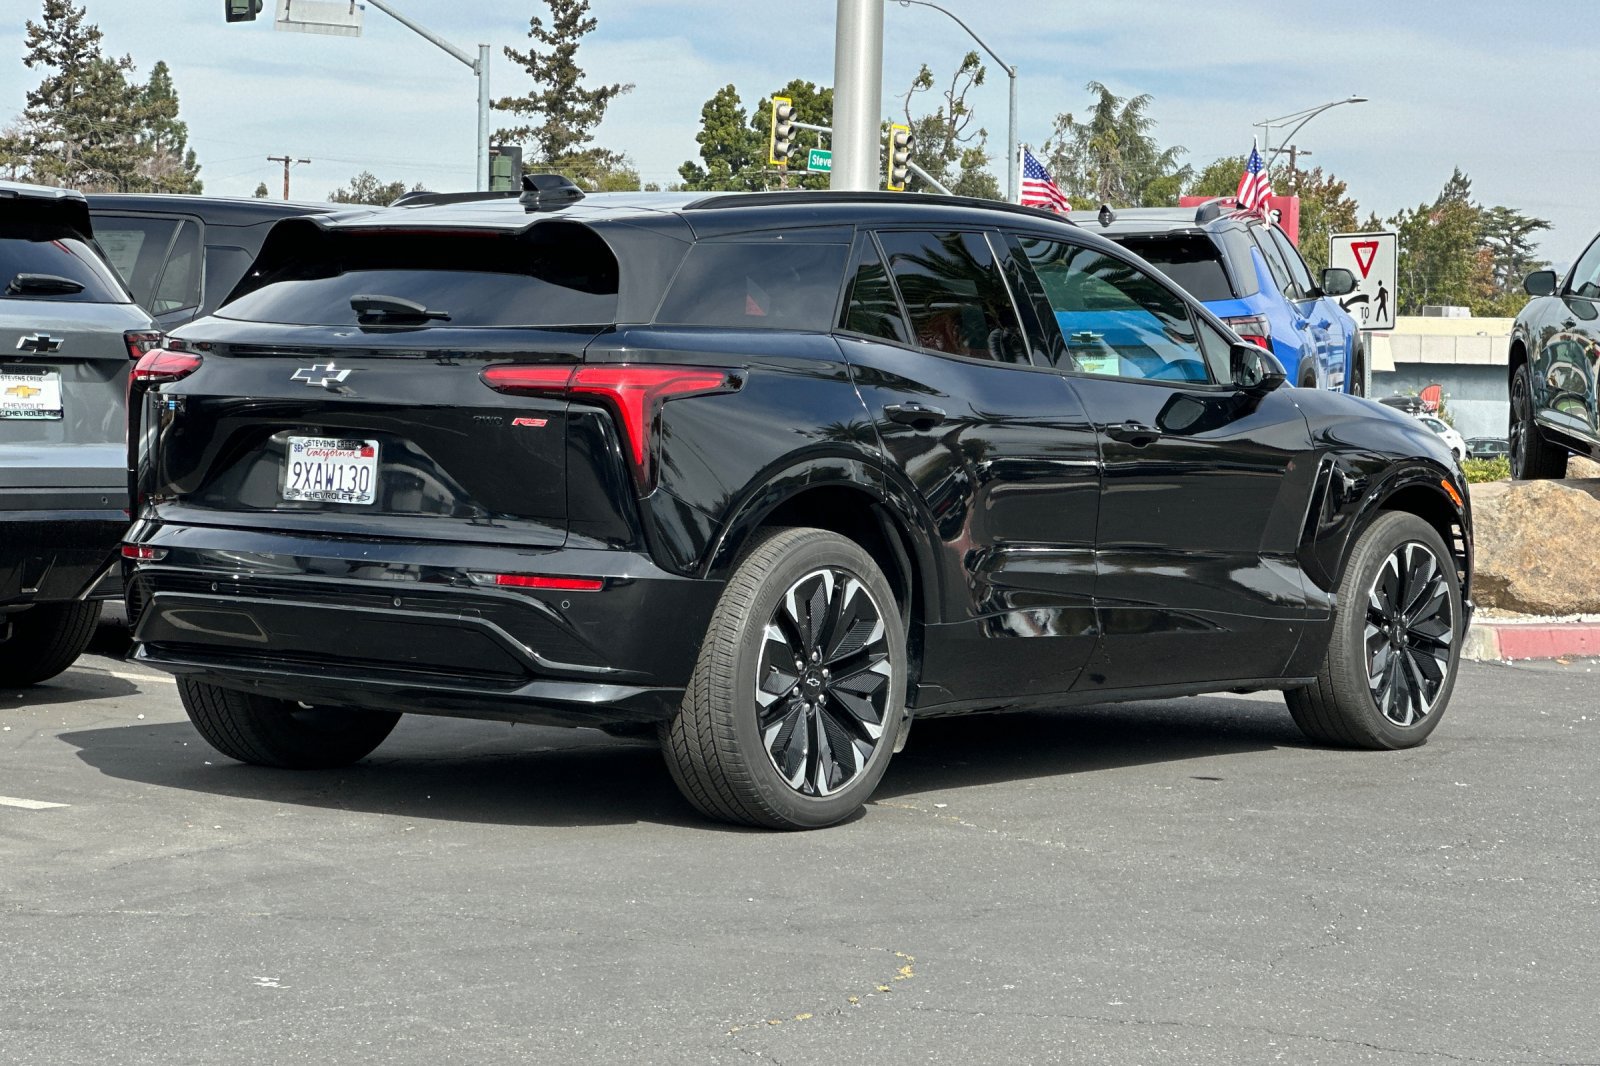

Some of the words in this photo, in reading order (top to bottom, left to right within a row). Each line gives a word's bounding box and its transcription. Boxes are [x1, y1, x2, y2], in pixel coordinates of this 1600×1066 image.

[812, 154, 832, 167] Steve
[1360, 306, 1370, 319] TO
[3, 402, 45, 410] CHEVROLET
[511, 417, 548, 428] RS
[308, 440, 336, 448] STEVENS
[292, 462, 369, 493] 9XAW130
[304, 491, 354, 501] CHEVROLET
